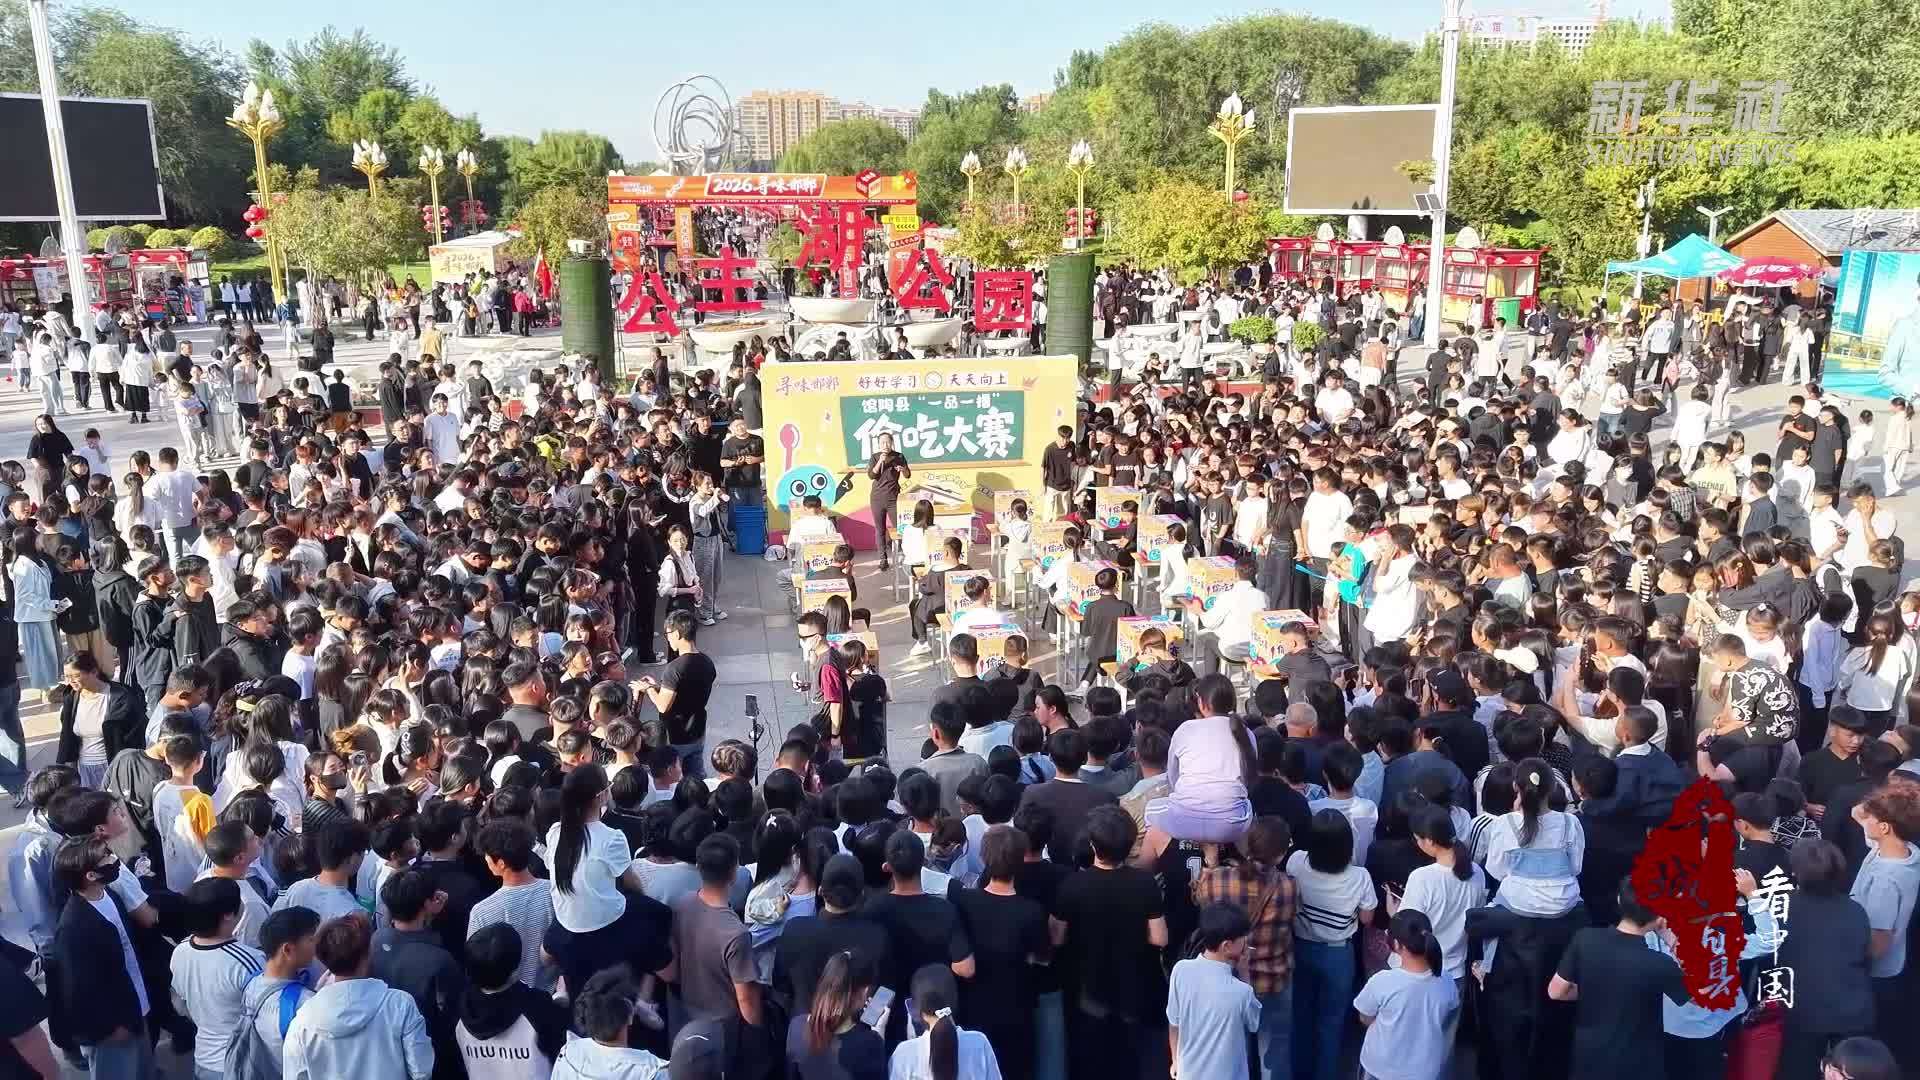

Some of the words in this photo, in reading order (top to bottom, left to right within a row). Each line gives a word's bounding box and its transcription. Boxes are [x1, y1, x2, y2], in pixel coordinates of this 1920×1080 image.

[776, 376, 840, 396] 寻味邯郸
[858, 376, 917, 389] 好好学习
[950, 373, 1008, 387] 天天向上
[853, 406, 1017, 460] 偷吃大赛
